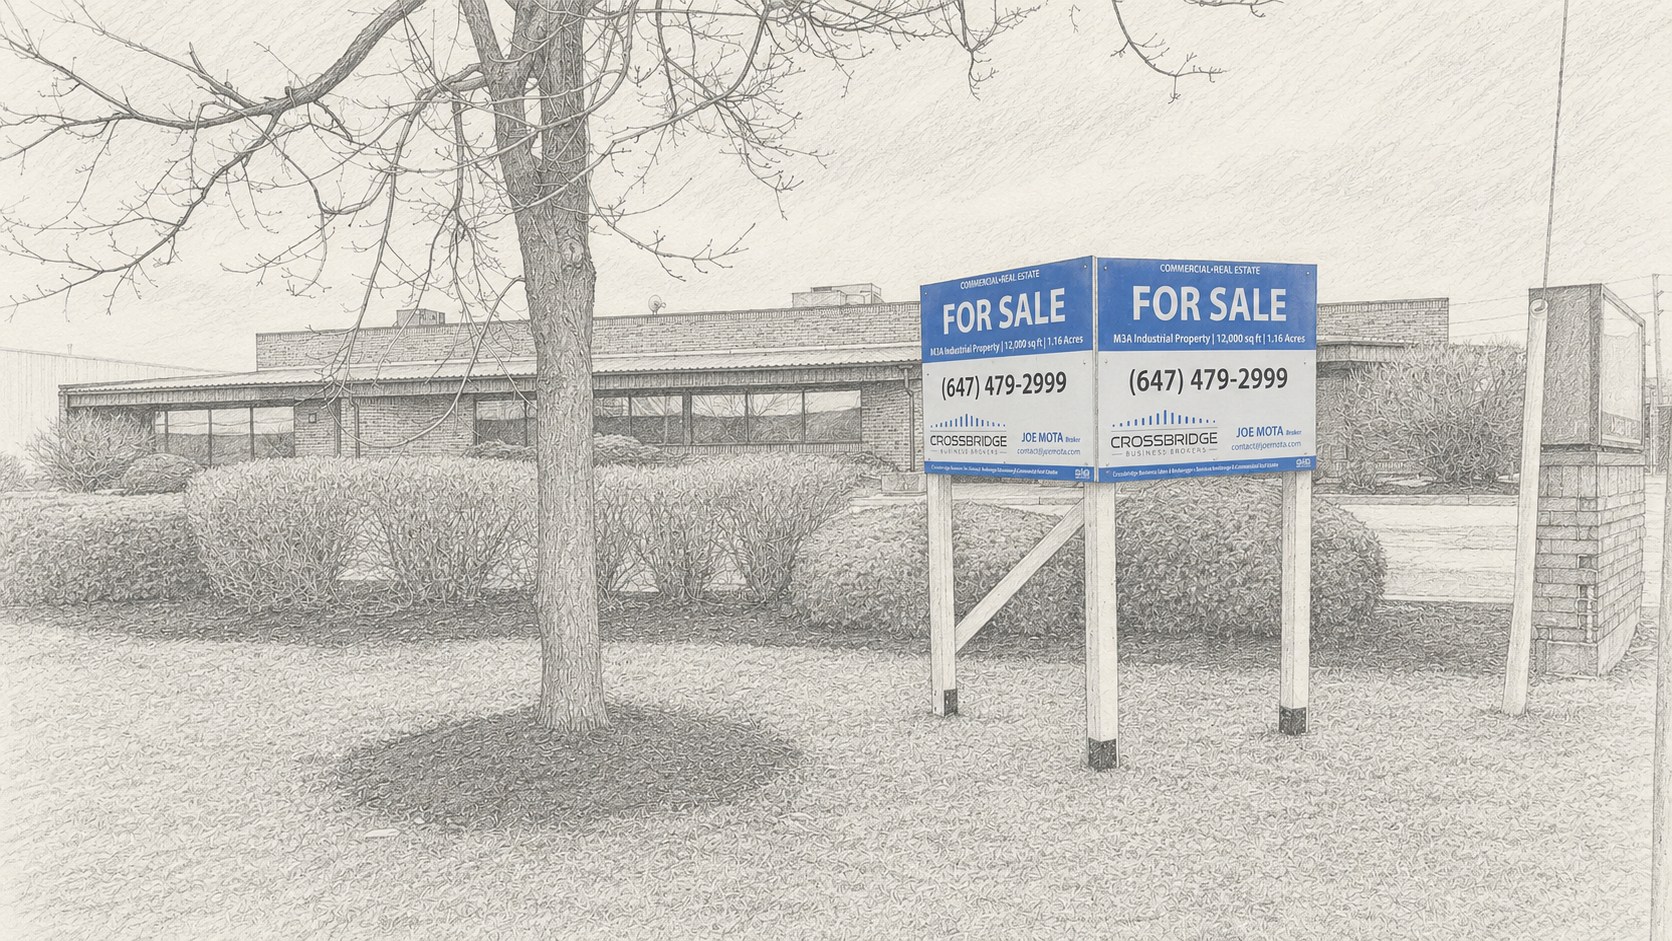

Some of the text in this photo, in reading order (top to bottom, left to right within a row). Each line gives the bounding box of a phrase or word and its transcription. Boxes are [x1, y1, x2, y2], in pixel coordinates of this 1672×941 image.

[1018, 270, 1040, 280] ESTATE
[1235, 266, 1260, 275] ESTATE
[1133, 286, 1286, 321] FOR SALE
[943, 288, 1065, 334] FOR SALE
[973, 342, 999, 355] Property
[1005, 339, 1026, 350] 12,000
[1028, 341, 1035, 350] sq
[1037, 337, 1042, 347] ft
[1048, 337, 1062, 346] 1.16
[1064, 336, 1083, 344] Acres
[1114, 334, 1132, 343] M3A
[1134, 334, 1173, 343] Industrial
[1175, 334, 1210, 345] Property
[1217, 334, 1242, 344] 12,000
[1245, 336, 1254, 345] sq
[1255, 334, 1261, 343] ft
[1267, 334, 1283, 343] 1.16
[1285, 334, 1305, 343] Acres
[942, 371, 1067, 400] (647) 479-2999
[1130, 367, 1288, 395] (647) 479-2999
[1022, 432, 1036, 443] JOE
[1038, 432, 1063, 443] MOTA
[1236, 427, 1254, 438] JOE
[1256, 426, 1283, 436] MOTA
[930, 435, 1007, 447] CROSSBRIDGE
[1111, 432, 1218, 448] CROSSBRIDGE
[1231, 441, 1301, 451] contact@joemota.com
[1126, 447, 1207, 457] BUSINESS BROKERS
